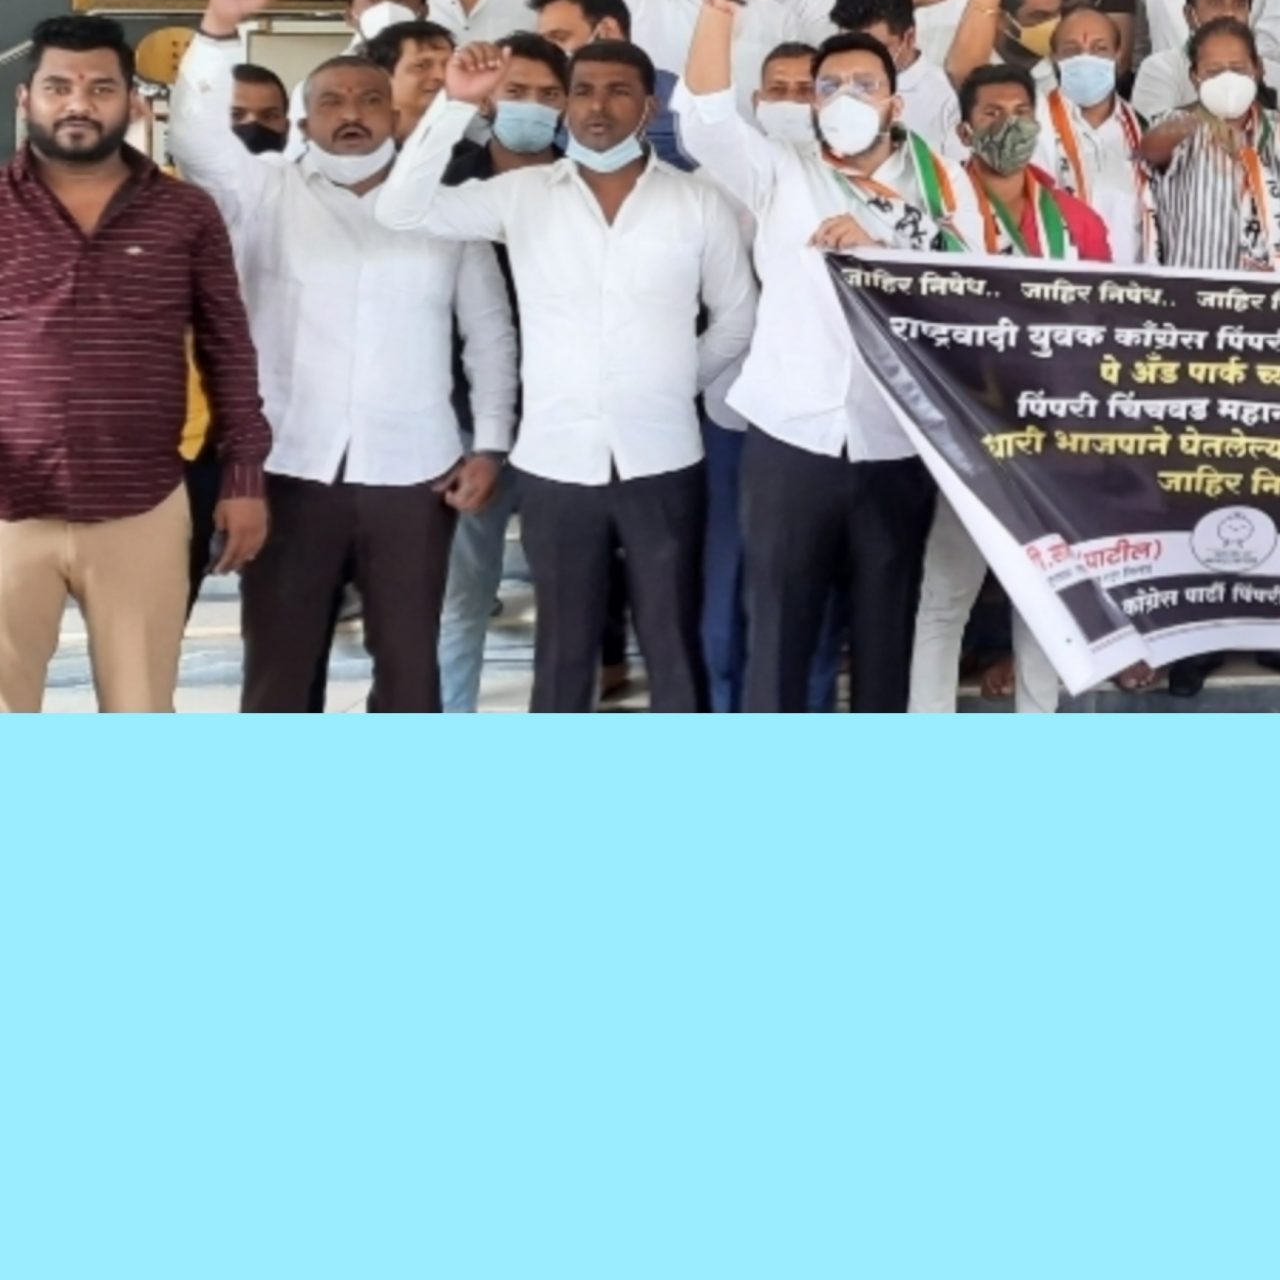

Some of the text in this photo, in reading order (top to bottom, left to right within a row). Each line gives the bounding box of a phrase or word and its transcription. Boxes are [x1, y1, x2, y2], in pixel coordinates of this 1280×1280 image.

[841, 267, 913, 296] जाहिर
[1021, 278, 1092, 305] जाहिर
[1196, 288, 1266, 312] जाहिर
[889, 317, 1018, 352] राष्ट्रवादी
[1028, 324, 1106, 357] युवक
[1188, 356, 1248, 385] पार्क
[1016, 388, 1099, 418] पिंपरी
[1107, 391, 1210, 421] चिंचवड
[1055, 426, 1171, 456] भाजपाने
[1158, 466, 1244, 498] जाहिर
